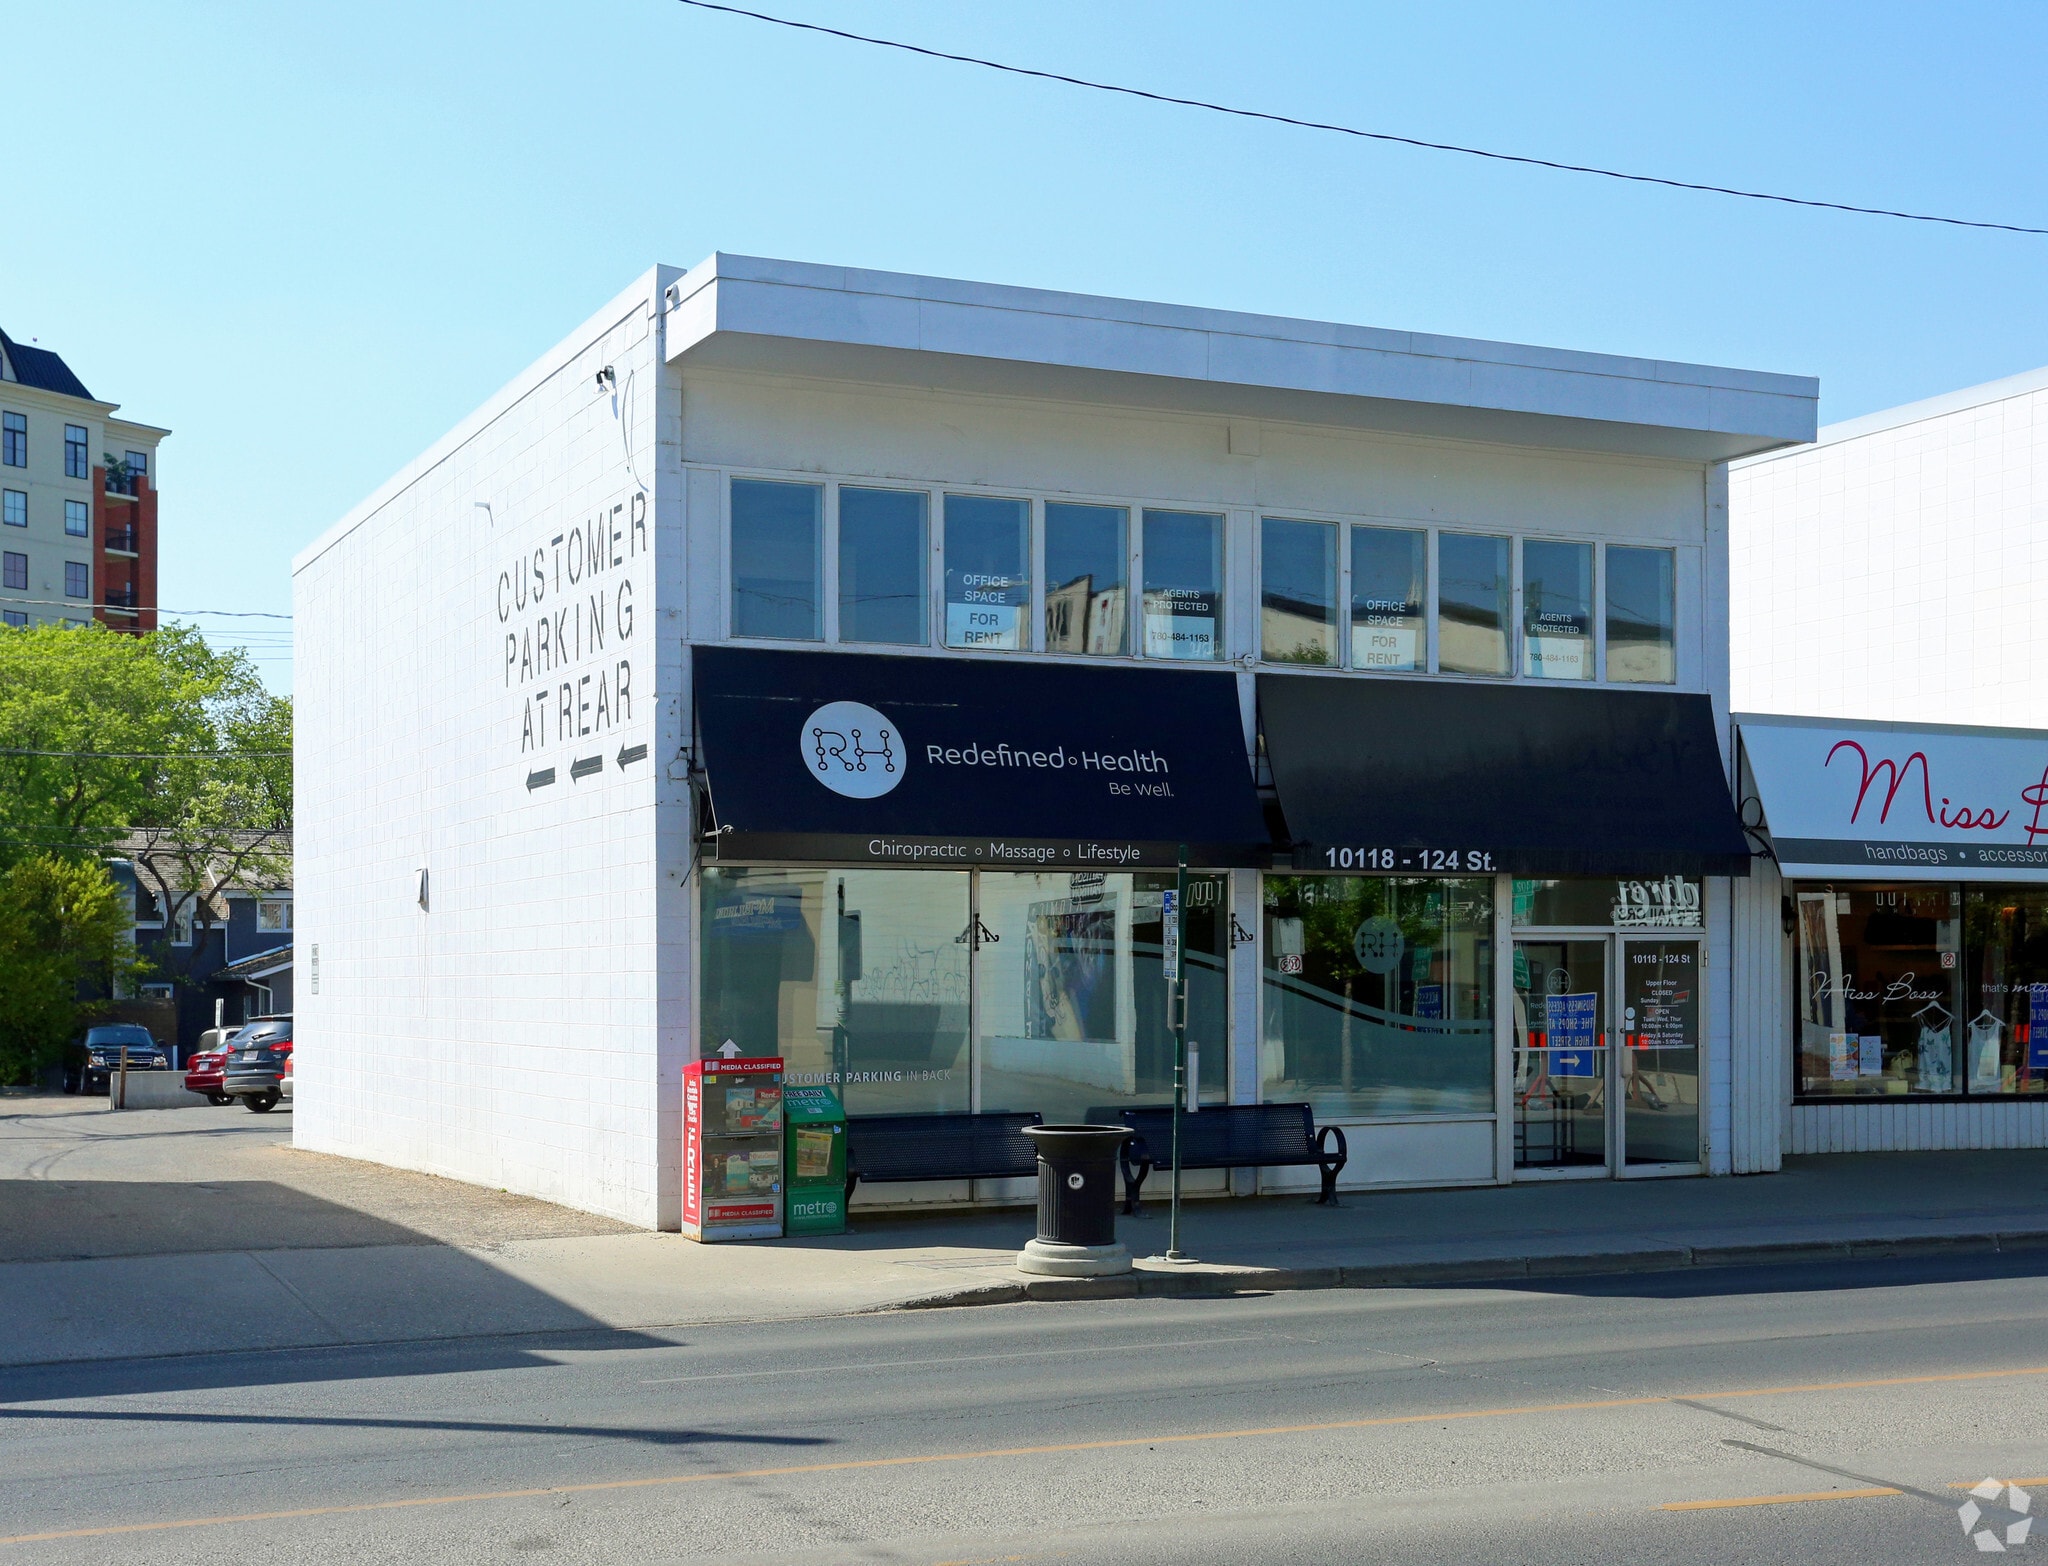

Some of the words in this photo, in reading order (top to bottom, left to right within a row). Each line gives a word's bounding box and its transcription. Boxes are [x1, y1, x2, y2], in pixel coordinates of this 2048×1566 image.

[498, 491, 647, 624] CUSTOMER
[963, 574, 1008, 588] OFFICE
[964, 590, 1006, 603] SPACE
[1163, 589, 1200, 599] AGENTS
[1153, 601, 1209, 611] PROTECTED
[1366, 600, 1406, 612] OFFICE
[969, 612, 999, 626] FOR
[1367, 615, 1403, 627] SPACE
[1539, 613, 1572, 622] AGENTS
[505, 579, 633, 688] PARKING
[1531, 623, 1579, 634] PROTECTED
[964, 631, 1003, 645] RENT
[1371, 635, 1398, 648] FOR
[1367, 652, 1401, 665] RENT
[522, 690, 548, 753] AT
[559, 660, 631, 741] REAR
[926, 742, 1066, 769] Redefined
[1081, 749, 1169, 774] Health
[1109, 781, 1131, 796] Be
[1134, 782, 1175, 798] Well.
[1825, 740, 2010, 829] Miss
[868, 839, 967, 860] Chiropractic
[989, 842, 1055, 863] Massage
[1078, 843, 1140, 863] Lifestyle
[1864, 843, 1948, 864] handbags
[1978, 848, 2048, 863] accessor
[1325, 847, 1394, 869] 10118
[1418, 849, 1459, 870] 124
[1466, 850, 1497, 872] St.
[1633, 954, 1657, 964] 10118
[1664, 954, 1679, 963] 124
[1681, 954, 1690, 963] St
[1809, 971, 1880, 1000] Miss
[1882, 972, 1943, 1005] Boss
[1982, 983, 2008, 993] that's
[782, 1073, 840, 1084] USTOMER
[846, 1071, 901, 1083] PARKING
[906, 1071, 918, 1081] IN
[922, 1069, 951, 1081] BACK
[793, 1201, 837, 1216] metro
